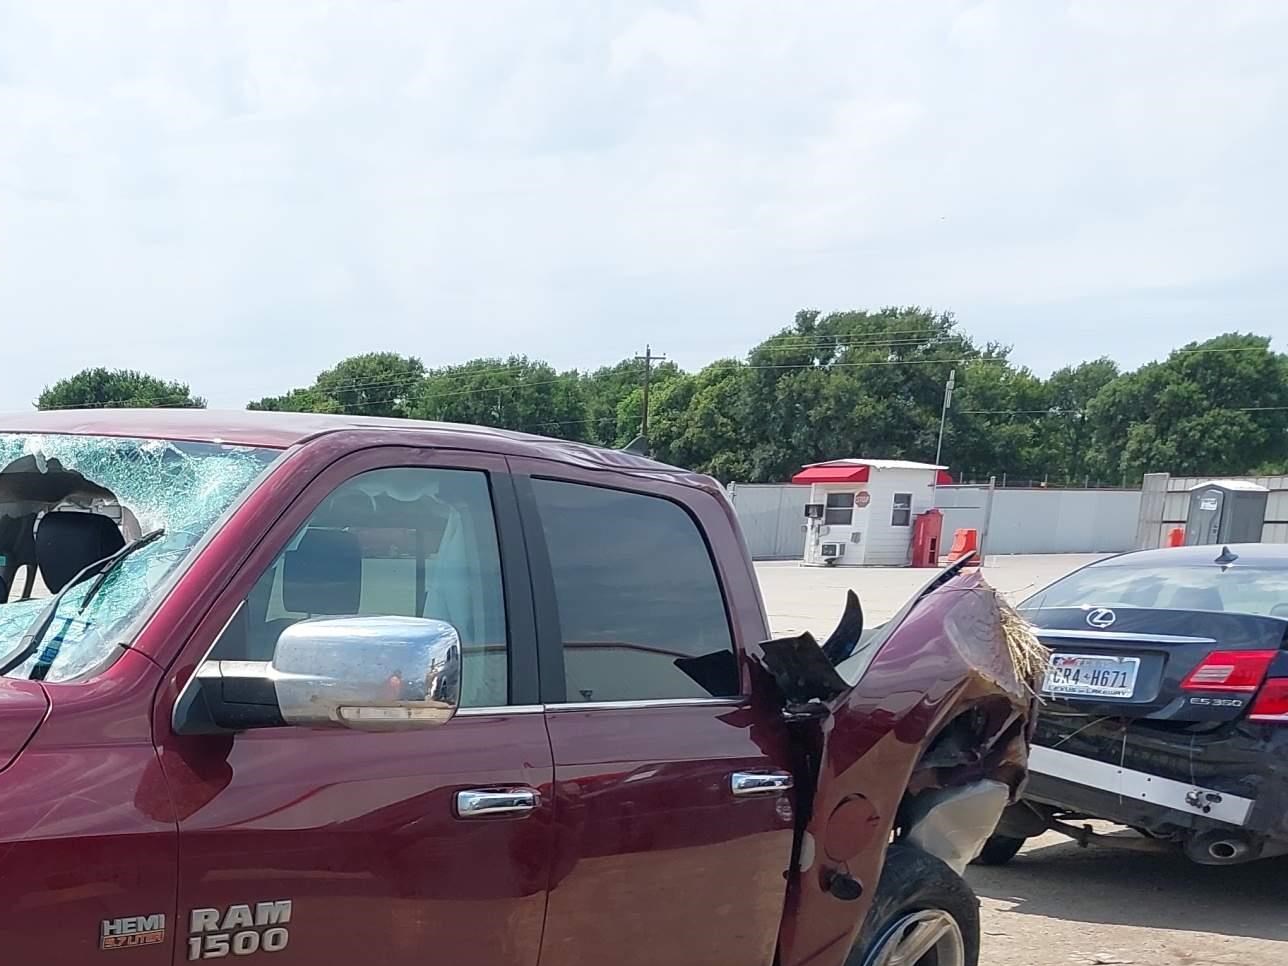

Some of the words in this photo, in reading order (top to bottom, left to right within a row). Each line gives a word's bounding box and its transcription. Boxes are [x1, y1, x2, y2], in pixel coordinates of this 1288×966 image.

[855, 495, 870, 504] STOP
[1211, 698, 1243, 707] 350
[102, 913, 166, 936] HEMI
[190, 899, 293, 933] RAM
[187, 927, 290, 961] 1500
